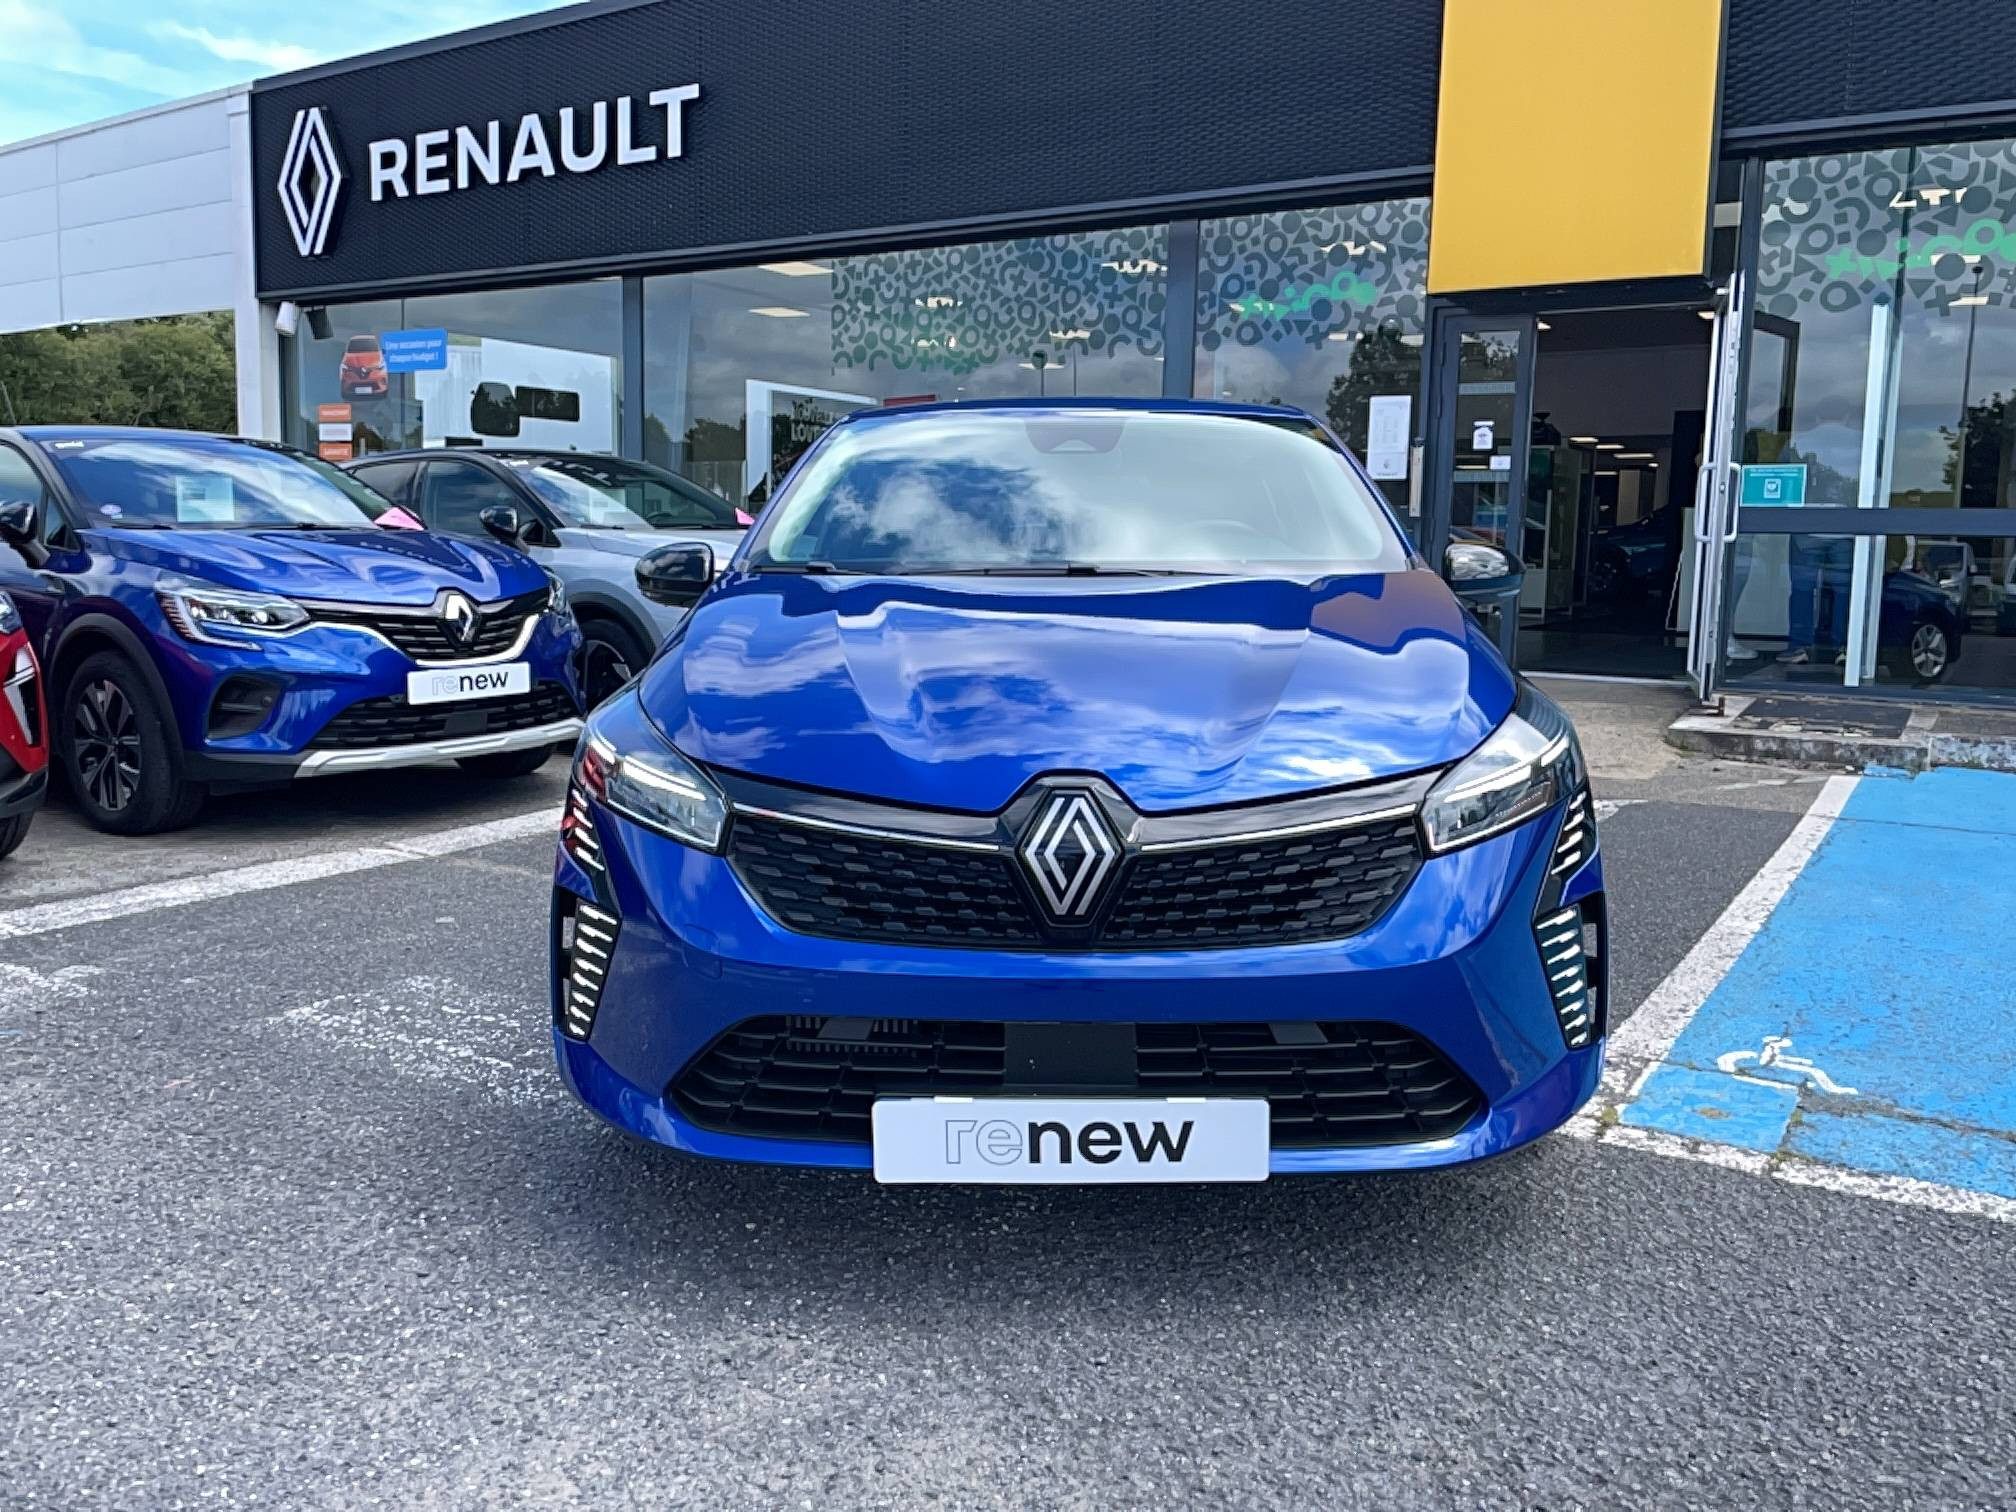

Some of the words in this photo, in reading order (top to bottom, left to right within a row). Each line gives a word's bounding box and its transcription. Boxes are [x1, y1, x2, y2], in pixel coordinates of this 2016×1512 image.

[368, 83, 701, 202] RENAULT
[432, 672, 509, 696] renew
[945, 1118, 1195, 1165] renew
